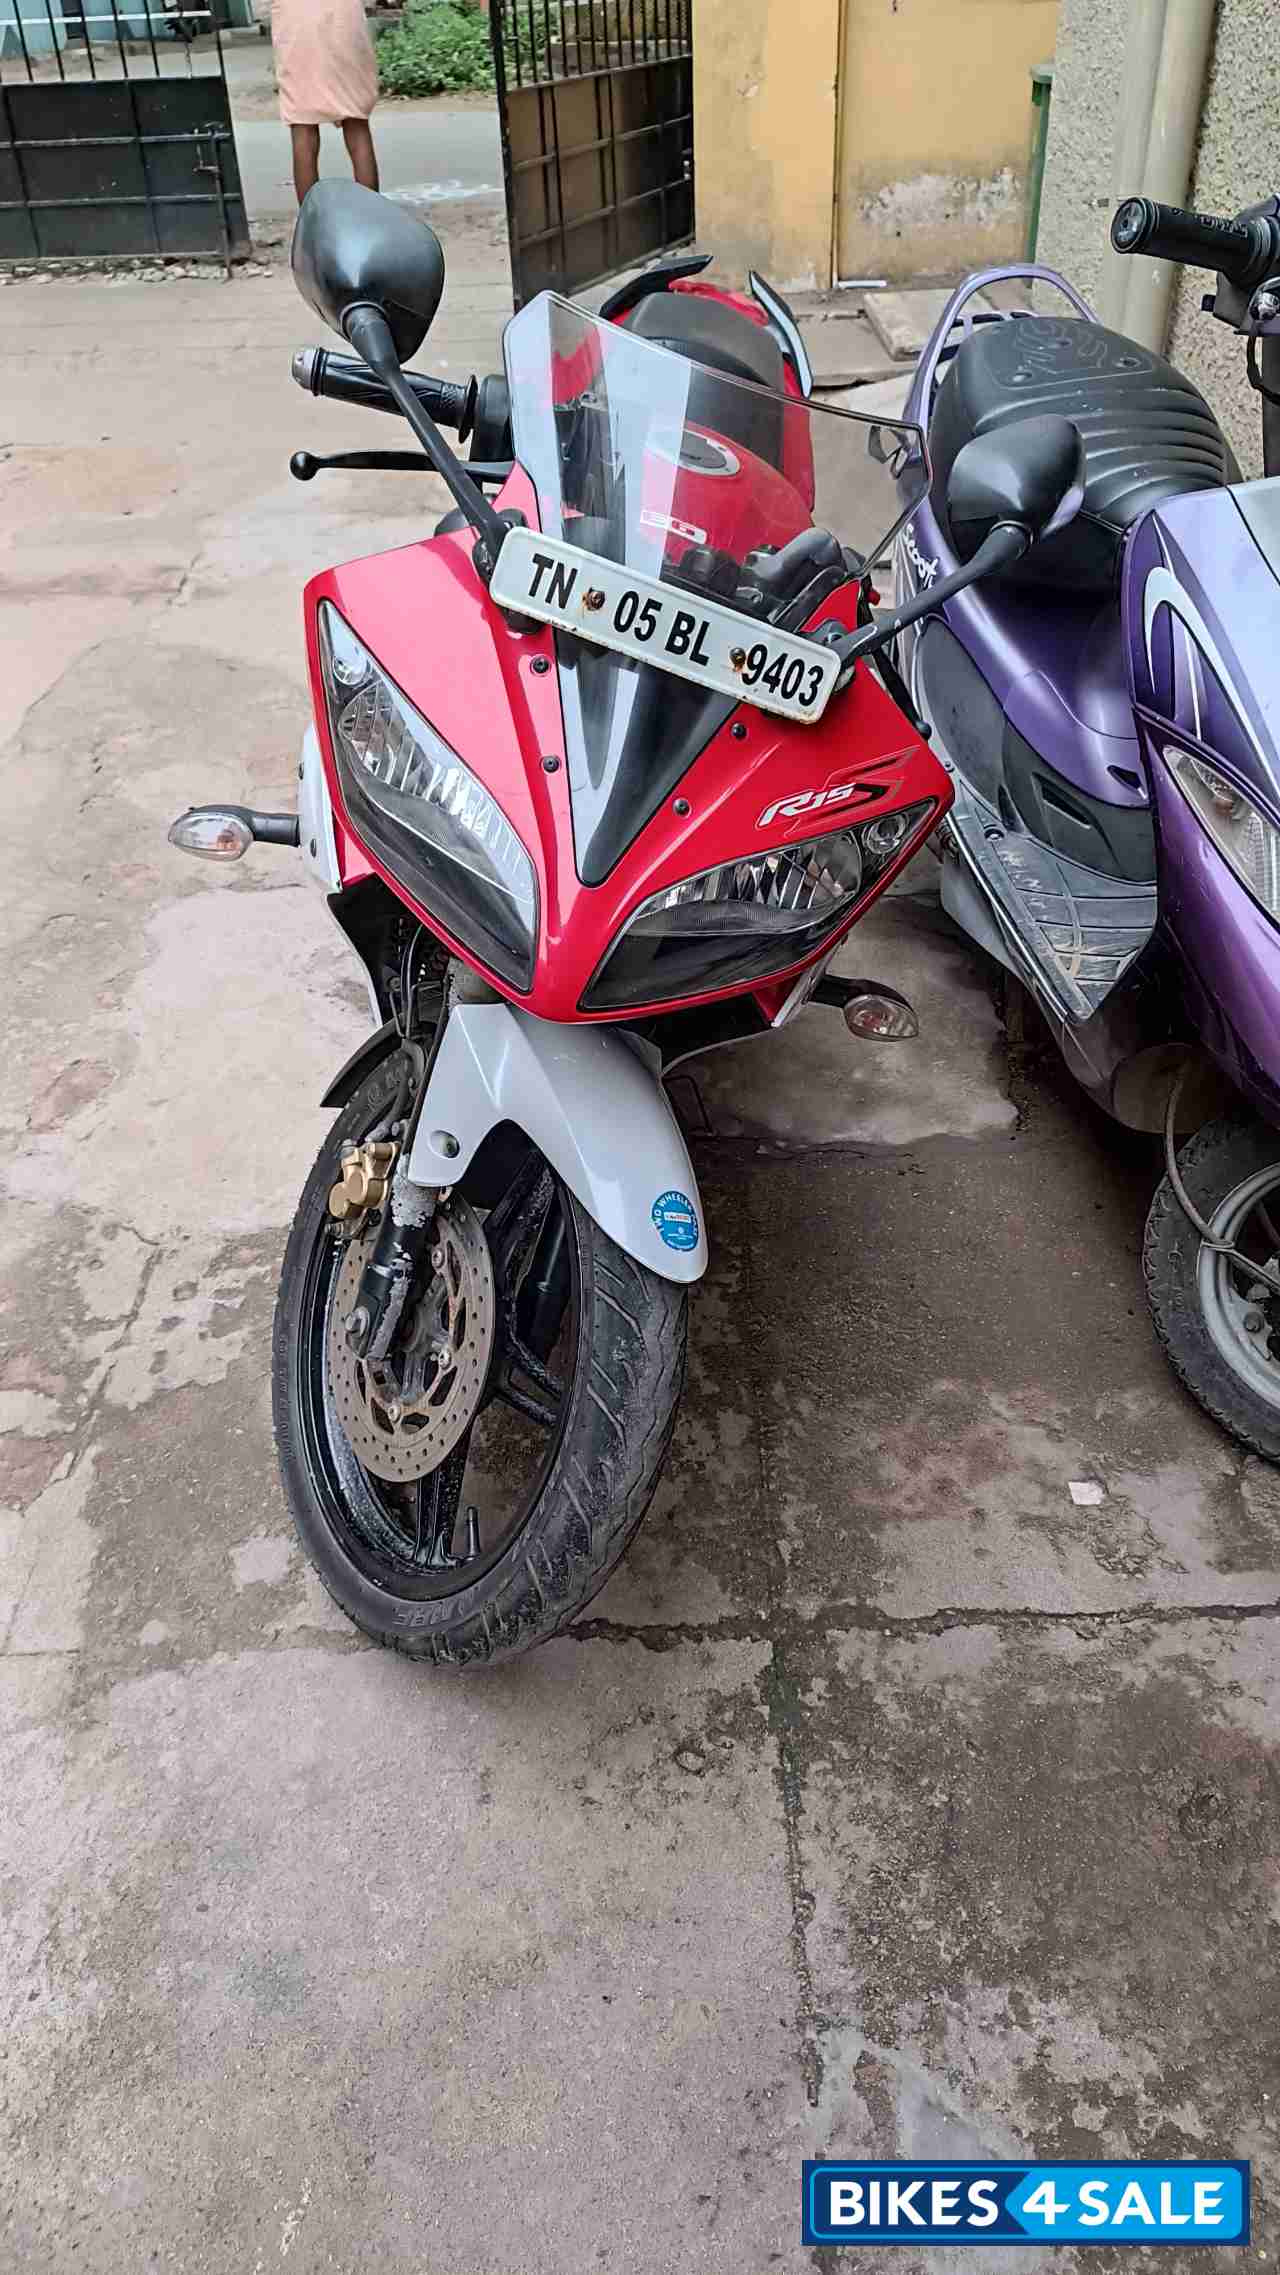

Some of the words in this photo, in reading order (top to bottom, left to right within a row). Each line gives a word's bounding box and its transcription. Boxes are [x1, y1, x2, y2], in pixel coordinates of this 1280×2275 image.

[528, 553, 578, 609] TN
[613, 590, 663, 642] 05
[664, 610, 711, 666] BL
[741, 643, 824, 706] 9403
[758, 782, 857, 827] R15
